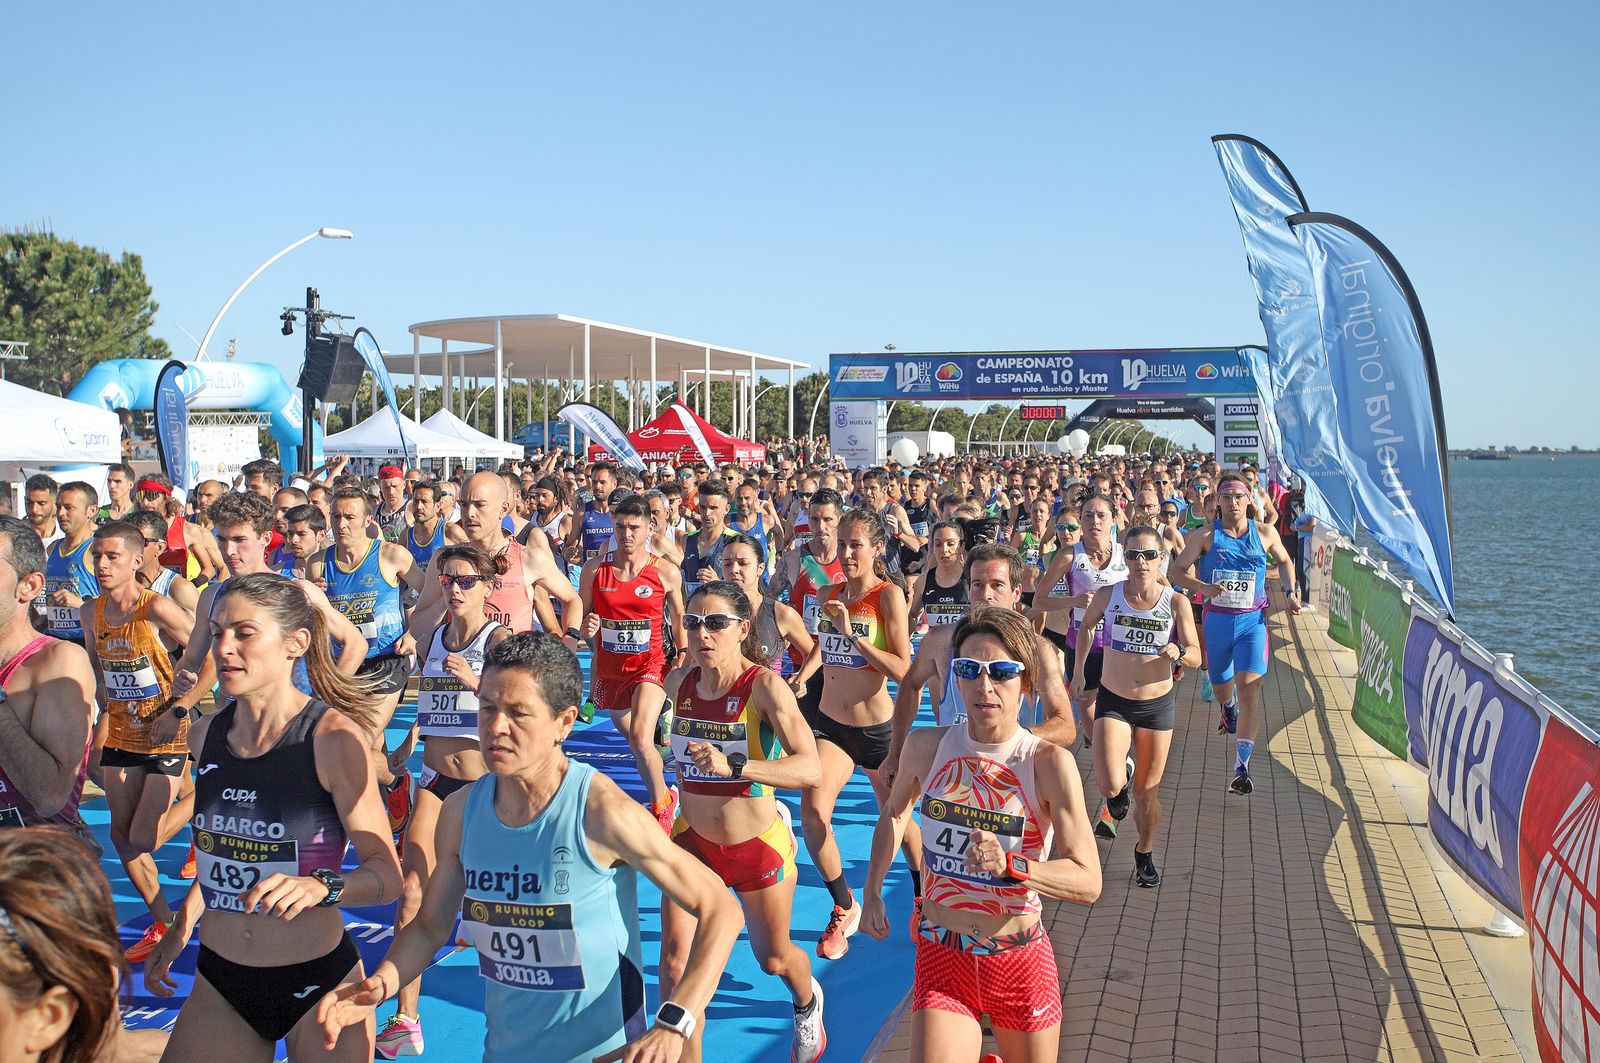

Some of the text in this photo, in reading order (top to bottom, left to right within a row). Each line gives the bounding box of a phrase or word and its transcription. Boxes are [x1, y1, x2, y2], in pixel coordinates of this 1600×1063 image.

[976, 356, 1074, 370] CAMPEONATO
[1146, 363, 1187, 377] HUELVA
[976, 368, 1108, 385] de ESPAÑA 10 km
[1220, 365, 1252, 378] WiH
[938, 382, 960, 390] WiHu
[1040, 385, 1073, 393] Absoluto
[1074, 386, 1080, 394] y
[52, 608, 73, 620] 161
[936, 615, 958, 624] 416
[617, 631, 635, 643] 62
[1125, 629, 1155, 644] 490
[825, 636, 852, 653] 479
[111, 674, 140, 688] 122
[431, 693, 458, 712] 501
[695, 722, 736, 732] RUNNING
[704, 731, 728, 740] LOOP
[953, 805, 1011, 824] RUNNING
[211, 814, 286, 839] BARCO
[966, 818, 999, 832] LOOP
[220, 836, 279, 852] RUNNING
[233, 850, 269, 861] LOOP
[209, 861, 262, 890] 482
[465, 864, 542, 901] nerja
[495, 903, 555, 917] RUNNING
[511, 917, 545, 928] LOOP
[490, 931, 542, 963] 491
